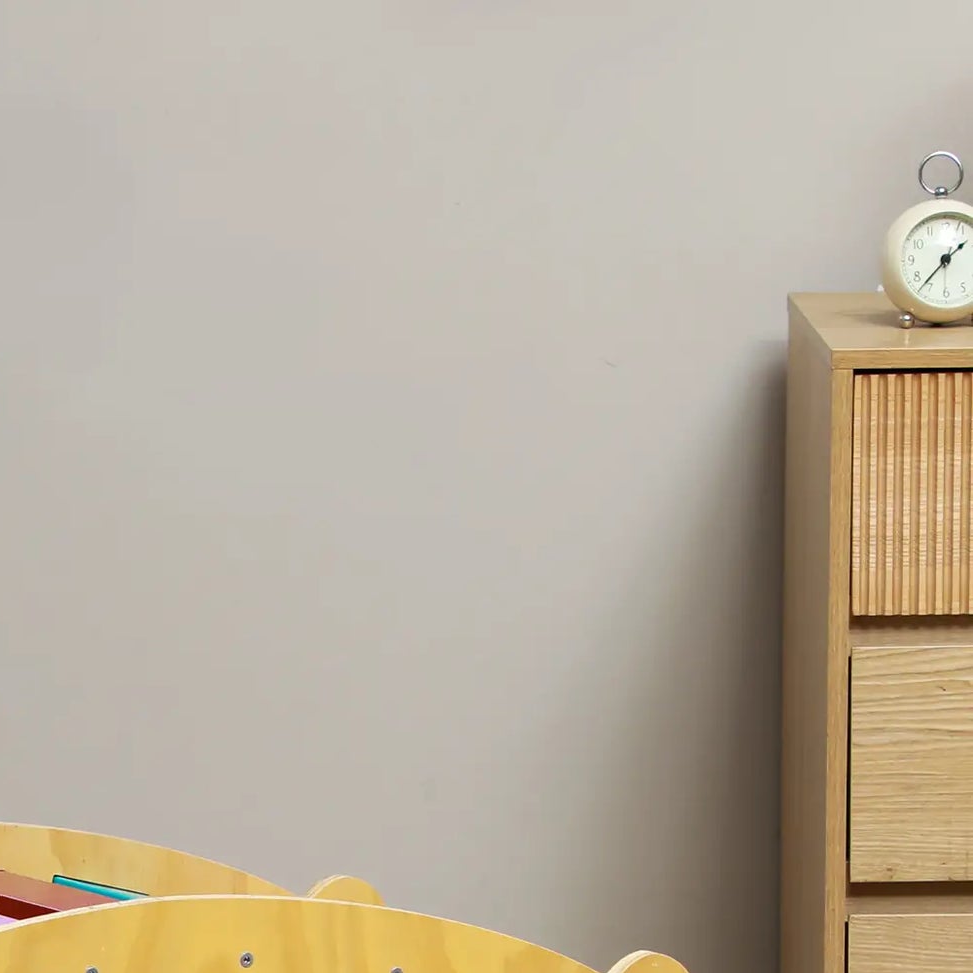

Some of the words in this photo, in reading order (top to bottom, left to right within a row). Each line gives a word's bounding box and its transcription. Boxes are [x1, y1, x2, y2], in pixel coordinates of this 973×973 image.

[913, 239, 924, 250] 10
[908, 255, 914, 265] 9
[913, 271, 921, 282] 8
[927, 282, 933, 292] 7
[943, 287, 950, 298] 6
[960, 282, 966, 293] 5
